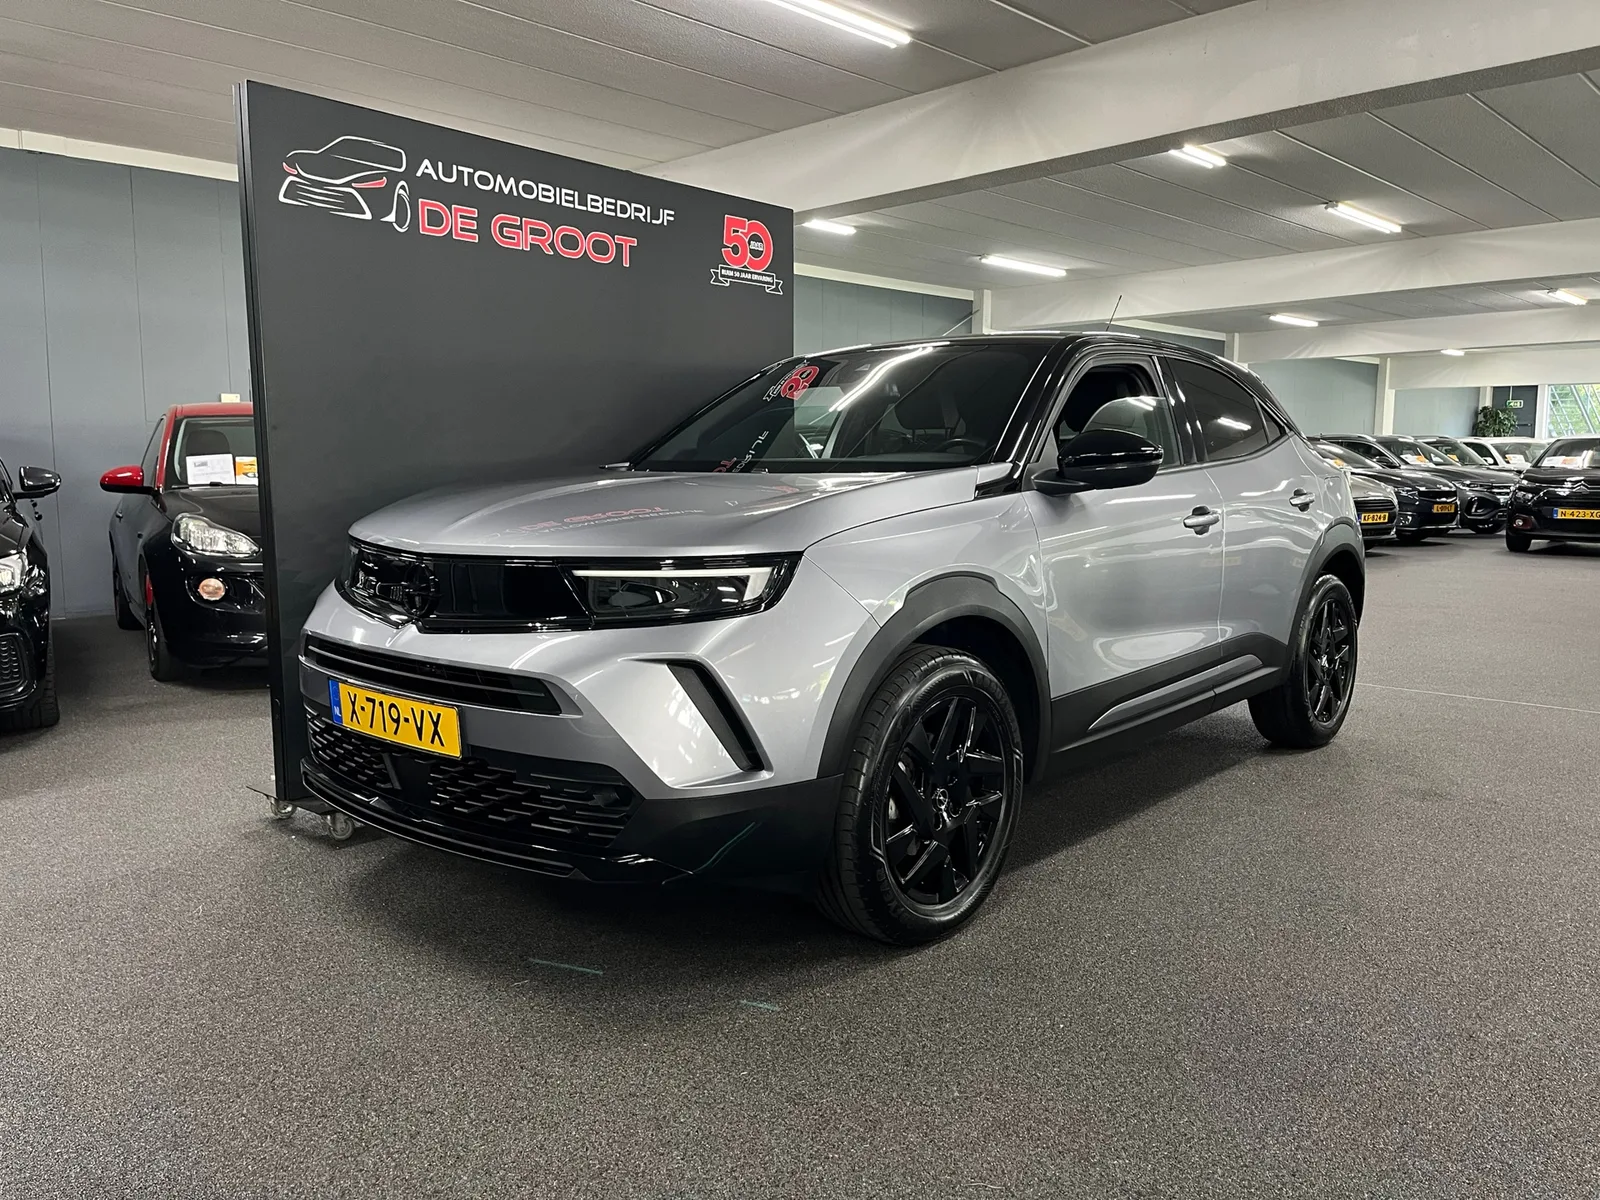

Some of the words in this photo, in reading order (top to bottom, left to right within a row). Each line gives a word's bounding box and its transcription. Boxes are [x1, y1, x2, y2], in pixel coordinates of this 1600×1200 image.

[416, 158, 675, 226] AUTOMOBIELBEDRIJF
[418, 198, 479, 243] DE
[490, 213, 638, 267] GROOT
[721, 214, 774, 272] 50
[734, 270, 740, 278] 50
[740, 272, 752, 280] JAAR
[334, 706, 341, 717] NL
[347, 691, 446, 747] X-719-VX
